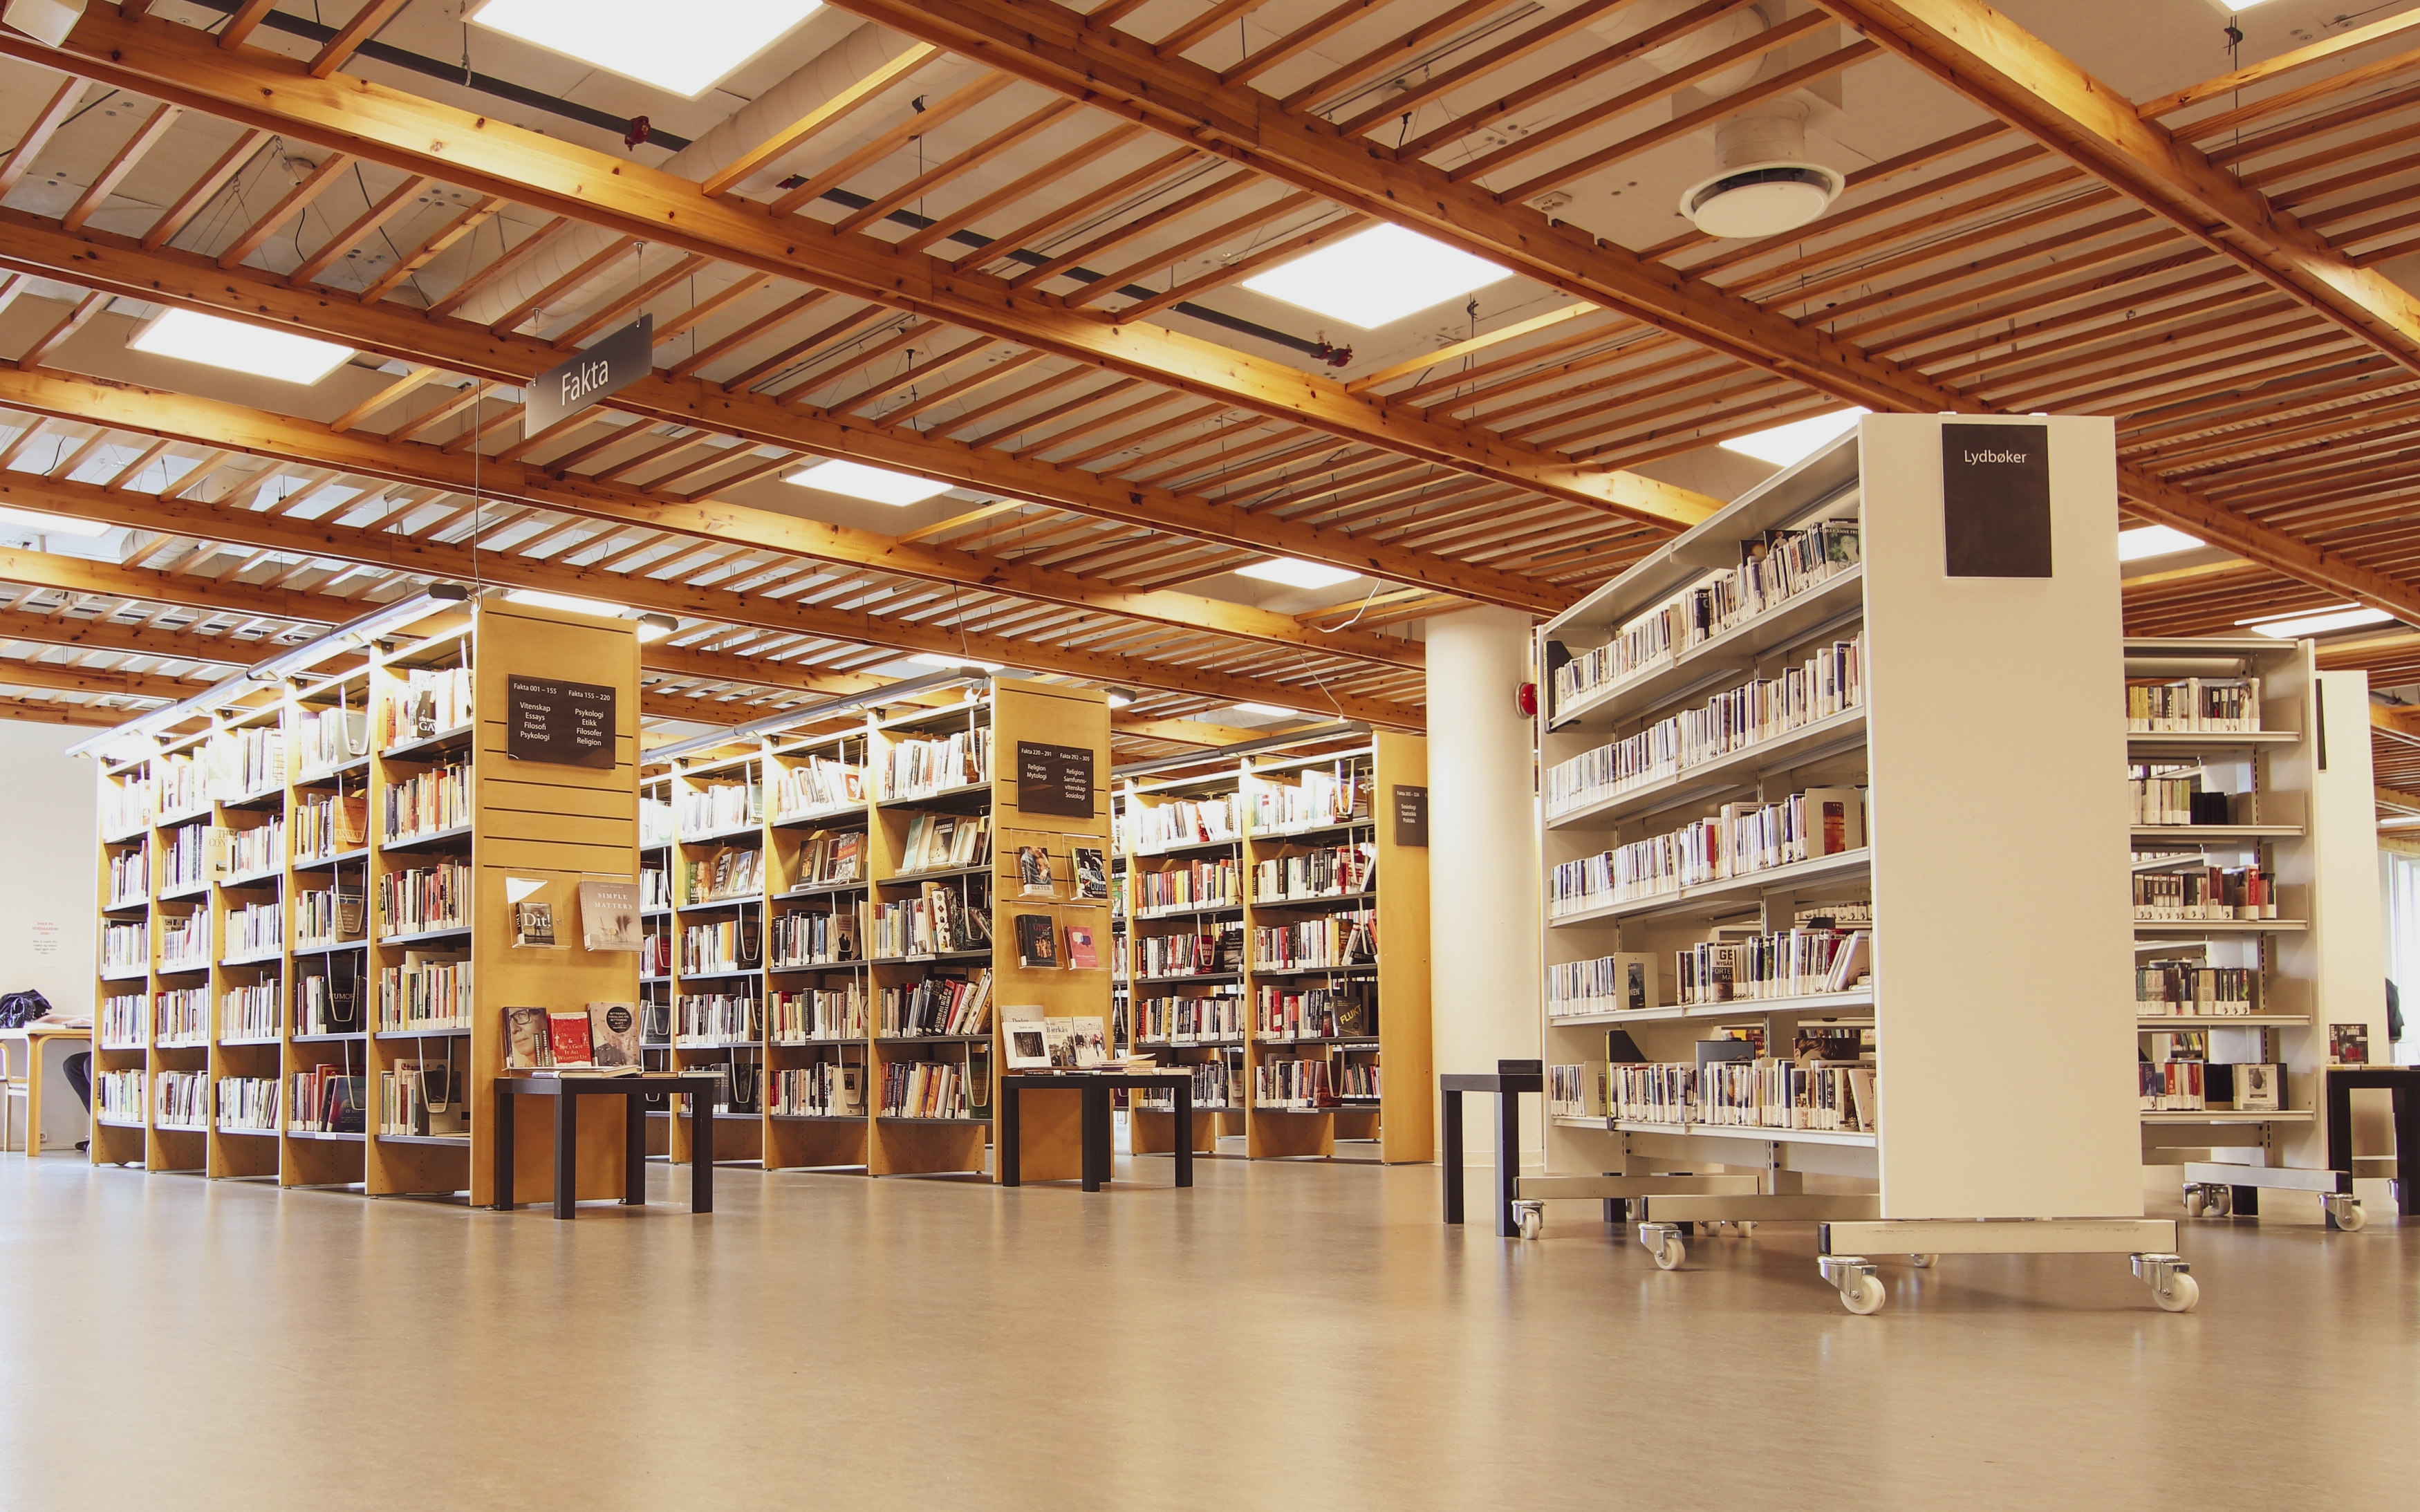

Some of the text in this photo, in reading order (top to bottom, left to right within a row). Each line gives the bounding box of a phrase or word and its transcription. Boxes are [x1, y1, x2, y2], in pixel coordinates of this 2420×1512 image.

[562, 360, 608, 406] Fakta
[1964, 450, 2027, 465] Lydbøker
[514, 683, 529, 691] Fakta
[520, 702, 551, 713] Vitenskap
[525, 712, 546, 721] Essays
[575, 708, 604, 719] Psykologi
[524, 722, 546, 730] Filosofi
[520, 731, 550, 742] Psykologi
[577, 727, 602, 737] Filosofer
[577, 737, 602, 747] Religion
[1027, 772, 1047, 781] Mytologi
[1066, 768, 1084, 776] Religion
[1063, 776, 1087, 784] Samfunns-
[1065, 792, 1086, 801] Sosiologi
[595, 902, 633, 910] MATTERS
[523, 913, 551, 928] Dit!
[1720, 950, 1732, 960] GE
[1340, 1004, 1362, 1025] FLUKT
